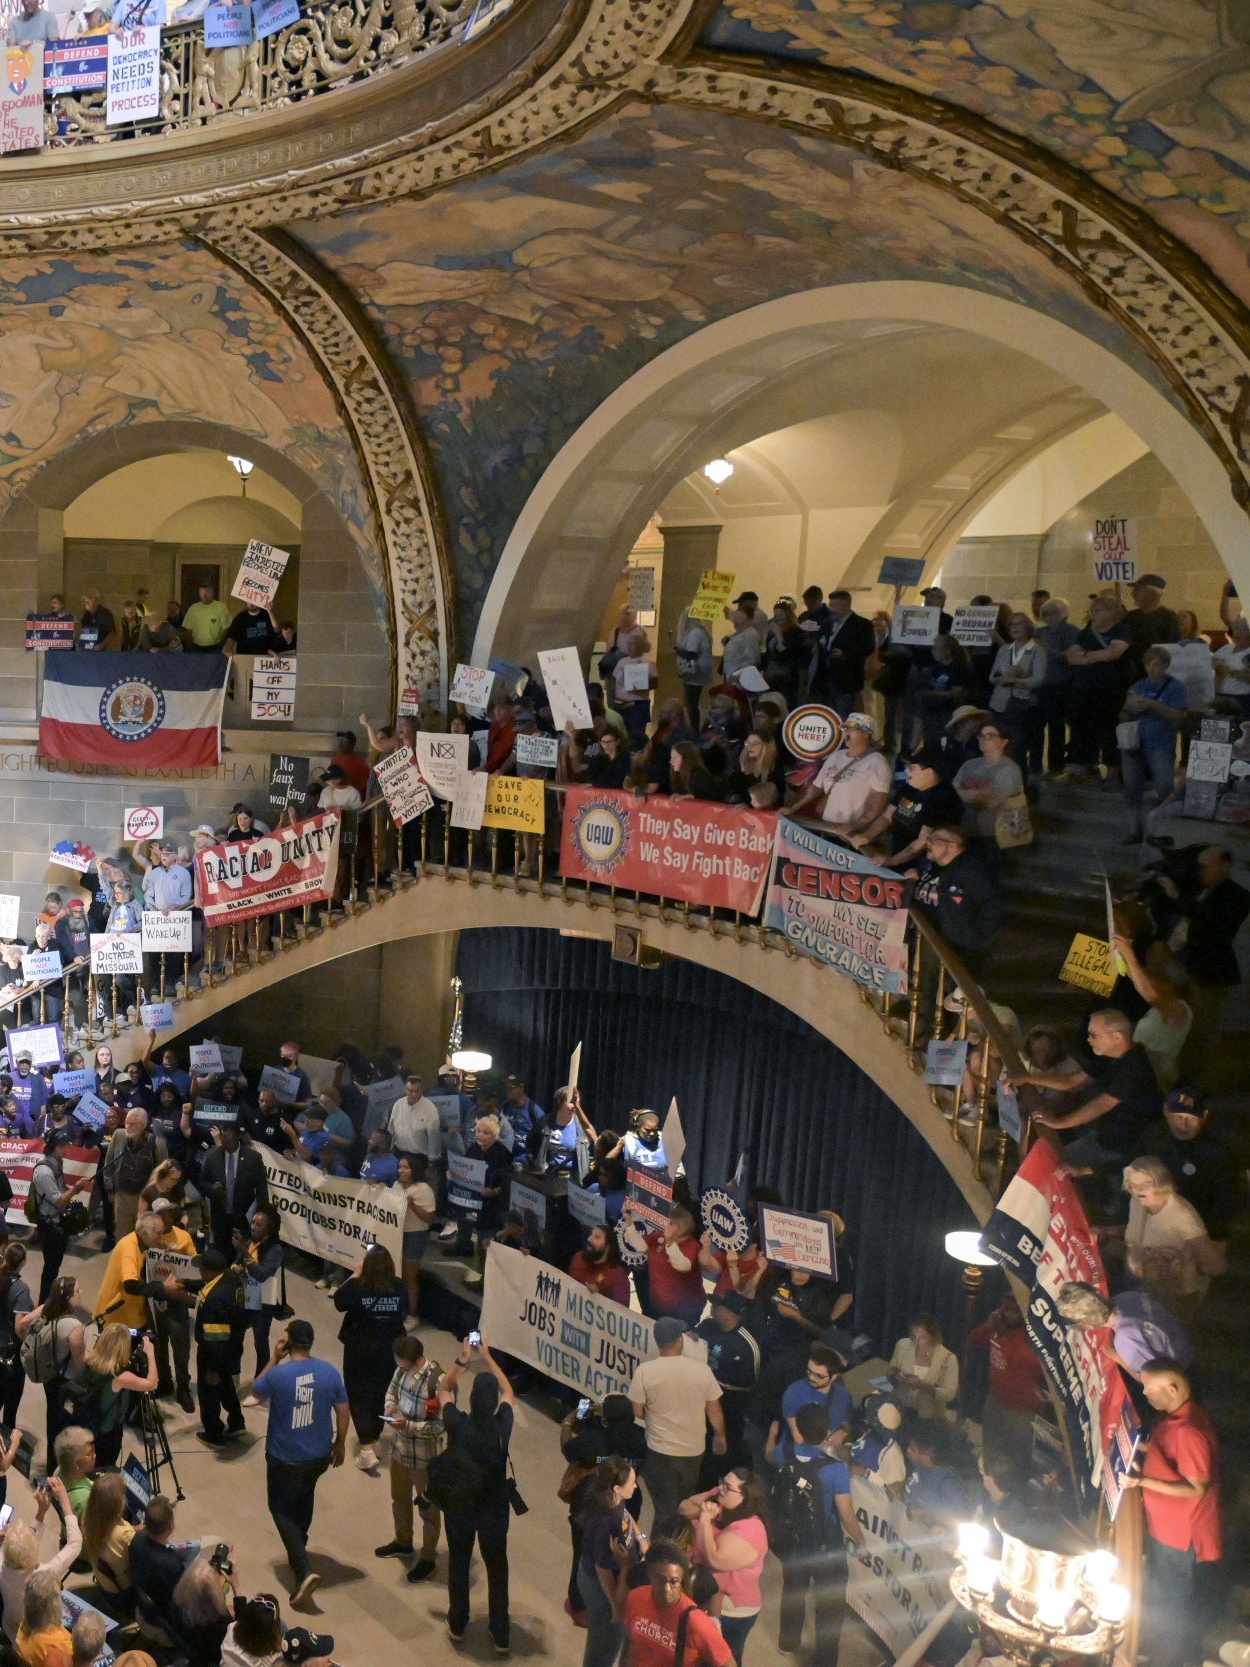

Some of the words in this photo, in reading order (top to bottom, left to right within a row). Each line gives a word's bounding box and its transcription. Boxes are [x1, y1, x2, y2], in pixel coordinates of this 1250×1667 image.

[217, 12, 243, 21] PEOPLE
[223, 21, 238, 29] NOT
[258, 7, 297, 32] POLITICIANS
[121, 35, 145, 49] OUR
[208, 30, 250, 40] POLITICIANS
[64, 48, 100, 59] DEFEND
[113, 49, 158, 65] DEMOCRACY
[112, 61, 155, 80] NEEDS
[45, 74, 103, 88] CONSTITUTION
[111, 76, 152, 94] PETITION
[111, 94, 157, 112] PROCESS
[1095, 518, 1126, 535] DON'T
[250, 540, 272, 557] WHEN
[1093, 535, 1130, 551] STEAL
[247, 551, 286, 574] INJUSTICE
[1095, 561, 1135, 581] VOTE!
[242, 577, 269, 594] BECOMES
[261, 660, 291, 671] HANDS
[461, 666, 485, 681] STOP
[266, 675, 283, 685] OFF
[267, 690, 281, 700] MY
[256, 702, 291, 717] 504!
[798, 723, 827, 734] UNITE
[798, 732, 826, 743] HERE!
[280, 756, 294, 771] No
[377, 748, 408, 774] WANTED
[270, 770, 293, 785] faux
[390, 773, 409, 788] WHO
[498, 781, 522, 791] SAVE
[270, 793, 288, 811] way
[287, 784, 306, 803] king
[497, 793, 519, 804] OUR
[402, 793, 432, 819] VOTERS!
[484, 804, 536, 825] DEMOCRACY
[586, 823, 614, 845] UAW
[638, 812, 669, 840] They
[673, 818, 699, 845] Say
[704, 823, 736, 847] Give
[205, 847, 273, 884] RACIAL
[280, 824, 337, 864] UNITY
[792, 829, 823, 860] WILL
[826, 848, 855, 870] NOT
[640, 841, 660, 863] We
[663, 848, 688, 874] Say
[692, 851, 731, 879] Fight
[782, 862, 906, 908] CENSOR
[226, 897, 254, 910] BLACK
[266, 887, 293, 900] WHITE
[788, 895, 805, 917] TO
[144, 913, 190, 925] REPUBLICANS
[215, 915, 226, 923] WE
[227, 911, 247, 921] FIGHT
[248, 907, 267, 918] WAGE
[267, 899, 296, 914] SLAVERY
[112, 941, 125, 952] NO
[30, 955, 51, 964] PEOPLE
[97, 950, 136, 962] DICTATOR
[1067, 951, 1111, 977] ILLEGAL
[25, 966, 59, 977] POLITICIANS
[96, 961, 138, 973] MISSOURI
[1060, 967, 1112, 998] REDISTRICTING
[195, 1049, 213, 1057] PEOPLE
[191, 1062, 222, 1070] POLITICIANS
[63, 1074, 85, 1083] PEOPLE
[272, 1073, 292, 1085] PEOPLE
[57, 1083, 94, 1095] POLITICIANS
[197, 1111, 237, 1121] DEMOCRACY
[203, 1104, 227, 1112] DEFEND
[639, 1177, 668, 1196] DEFEND
[266, 1168, 301, 1190] NITED
[356, 1197, 399, 1228] RACISM
[272, 1194, 308, 1218] GOOD
[308, 1208, 337, 1230] JOBS
[338, 1221, 361, 1240] FOR
[626, 1199, 669, 1228] CONSTITUTION
[712, 1210, 735, 1233] UAW
[805, 1244, 821, 1254] NOT
[1069, 1235, 1097, 1267] MISSOURI
[163, 1253, 189, 1267] CAN'T
[519, 1299, 556, 1337] JOBS
[562, 1325, 586, 1351] WITH
[566, 1289, 650, 1354] MISSOURI
[536, 1336, 581, 1384] VOTER
[1030, 1297, 1083, 1407] SUPREME
[295, 1387, 315, 1400] FIGHT
[634, 1620, 677, 1648] CHURCH
[640, 1616, 650, 1625] WE
[650, 1619, 661, 1629] ARE
[662, 1625, 675, 1638] THE
